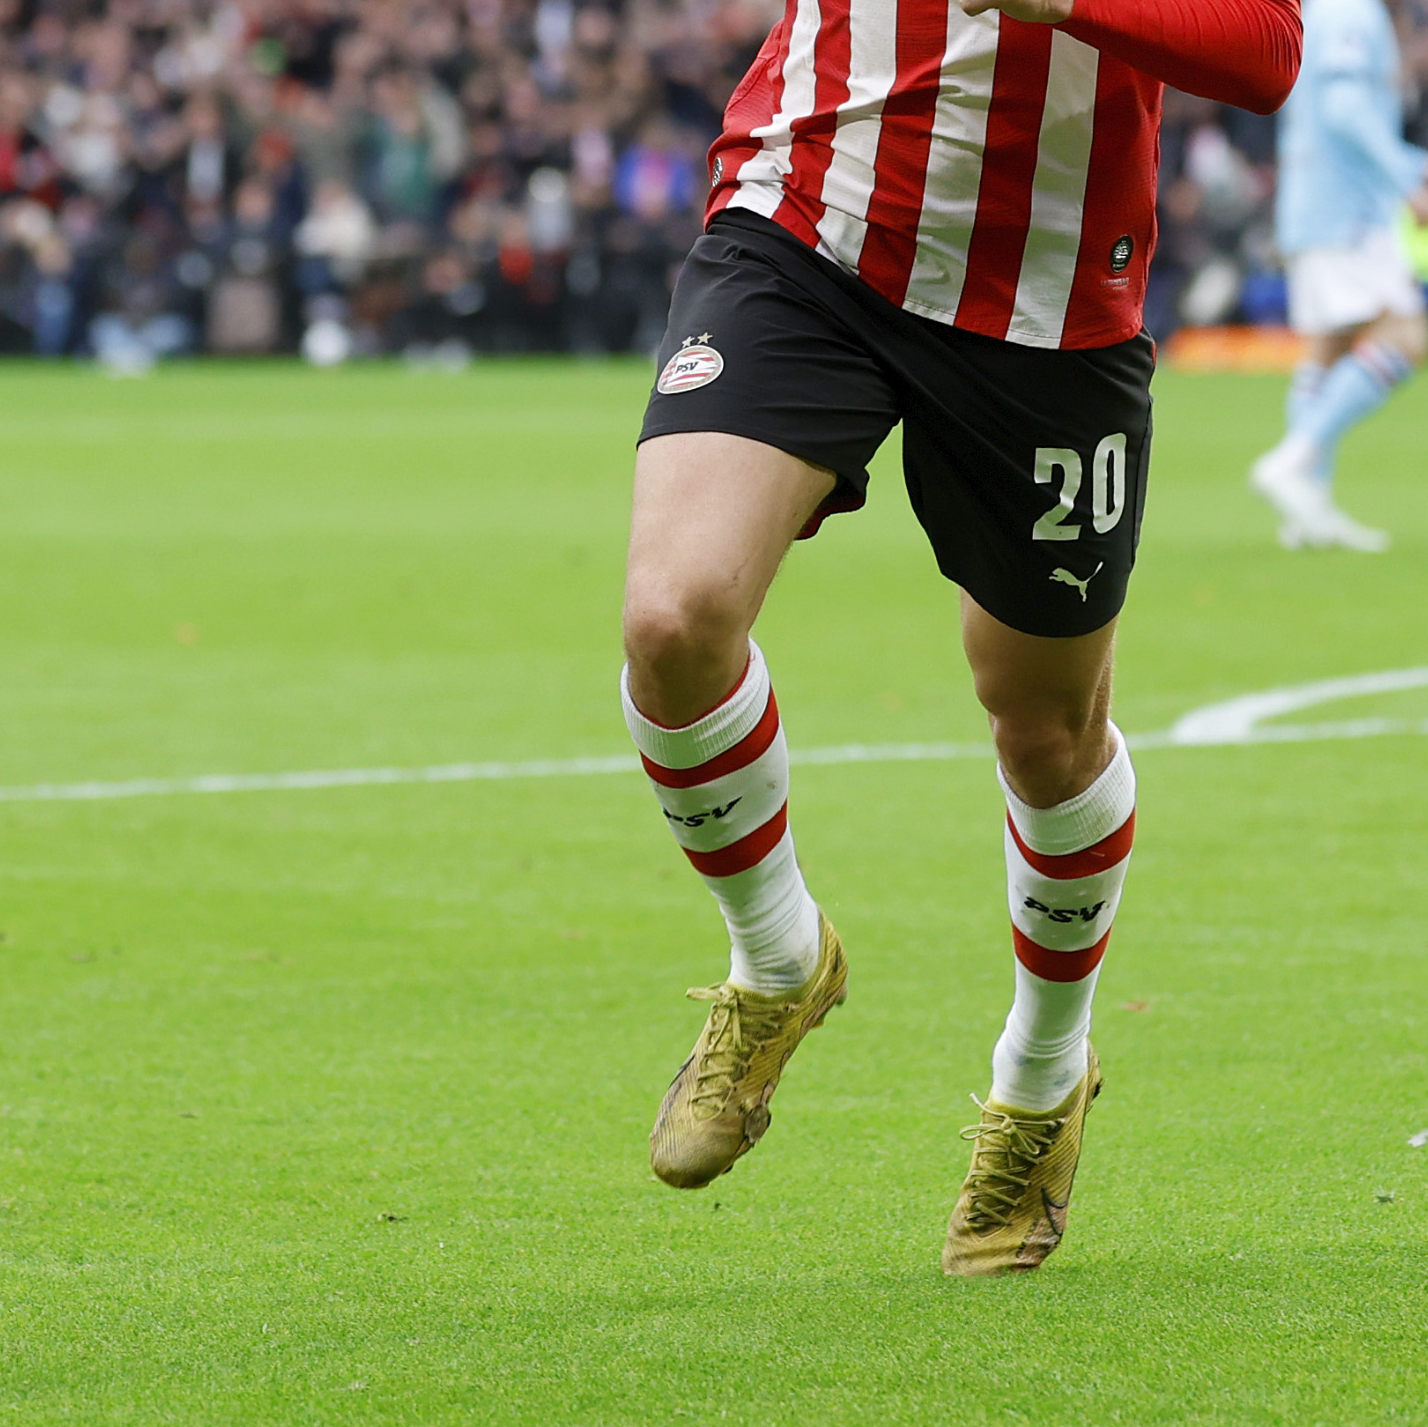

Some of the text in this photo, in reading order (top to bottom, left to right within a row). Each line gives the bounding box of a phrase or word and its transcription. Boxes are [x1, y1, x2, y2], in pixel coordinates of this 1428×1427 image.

[675, 361, 699, 375] PSV
[1032, 432, 1127, 541] 20
[1023, 896, 1106, 924] PSV
